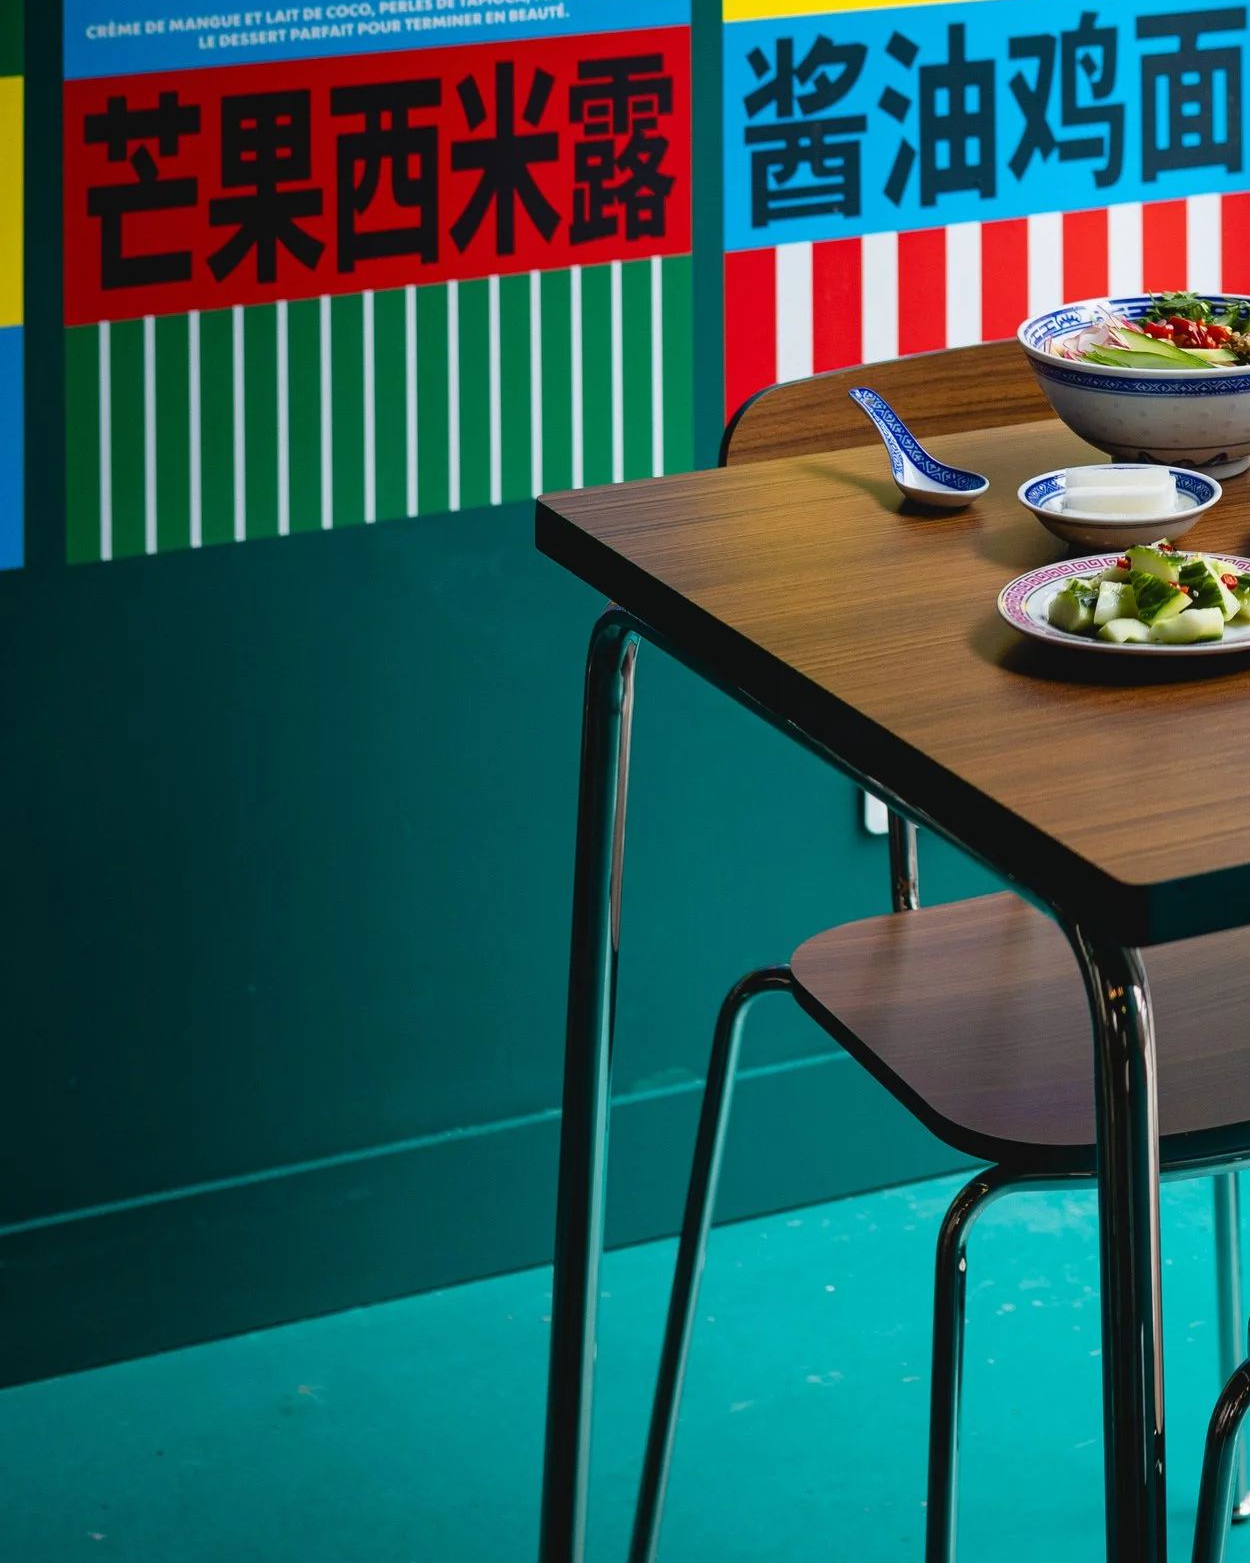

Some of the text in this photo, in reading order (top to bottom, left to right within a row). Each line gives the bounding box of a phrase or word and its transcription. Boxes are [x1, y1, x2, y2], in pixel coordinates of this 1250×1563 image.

[85, 18, 141, 39] CRÈME
[145, 20, 165, 34] DE
[169, 11, 242, 32] MANGUE
[244, 10, 262, 26] ET
[265, 7, 299, 25] LAIT
[303, 5, 322, 21] DE
[326, 1, 376, 19] COCO,
[198, 3, 570, 51] LE DESSERT PARFAIT POUR TERMINER EN BEAUTÉ.
[83, 52, 676, 291] 芒果西米露
[743, 5, 1247, 228] 酱油鸡面
